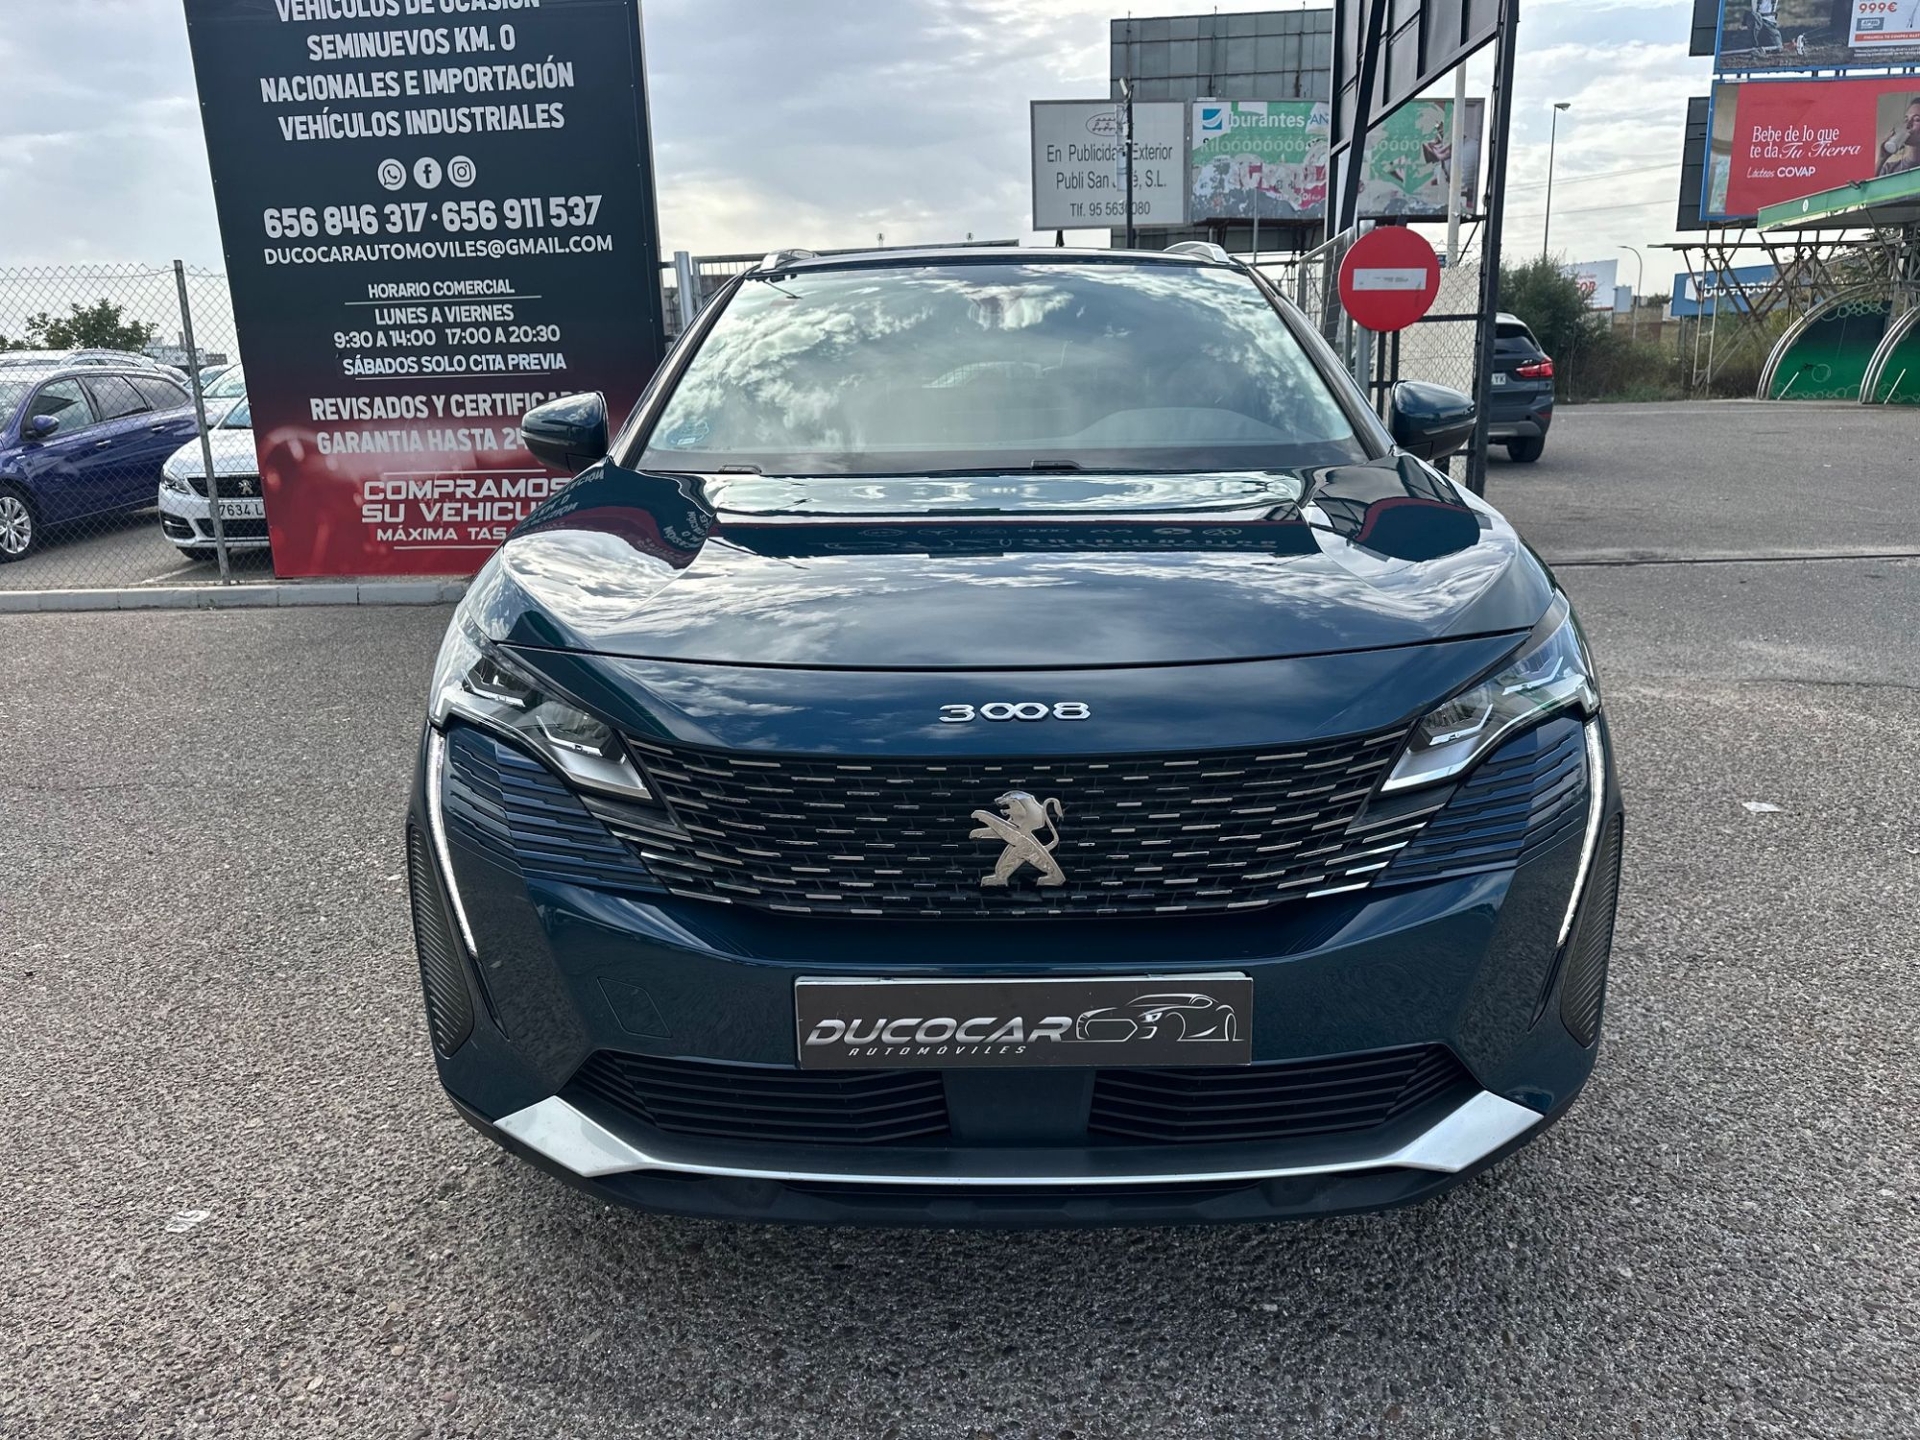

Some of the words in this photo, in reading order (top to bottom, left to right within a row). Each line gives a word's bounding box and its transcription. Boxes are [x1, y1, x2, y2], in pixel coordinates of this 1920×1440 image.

[1859, 2, 1897, 13] 999€
[307, 28, 450, 60] SEMINUEVOS
[454, 26, 496, 53] KM.
[260, 69, 400, 103] NACIONALES
[406, 69, 420, 96] E
[423, 56, 575, 94] IMPORTACIÓN
[278, 106, 401, 141] VEHÍCULOS
[406, 102, 565, 135] INDUSTRIALES
[1229, 112, 1305, 128] burantes
[1752, 125, 1782, 142] Bebe
[1784, 125, 1800, 141] de
[1803, 124, 1814, 141] lo
[1817, 128, 1840, 143] que
[1047, 144, 1062, 162] En
[1069, 143, 1119, 162] Publicida
[1750, 144, 1762, 158] te
[1763, 142, 1779, 158] da
[1779, 142, 1805, 159] Tu
[1808, 141, 1863, 158] Tierra
[1056, 170, 1084, 190] Publi
[1087, 170, 1110, 189] San
[1145, 169, 1167, 188] S.L.
[1777, 166, 1816, 178] COVAP
[263, 207, 319, 239] 656
[324, 204, 379, 236] 846
[504, 197, 545, 230] 911
[549, 194, 603, 228] 537
[1089, 202, 1103, 216] 95
[1106, 200, 1151, 216] 563080
[264, 234, 614, 265] DUCOCARAUTOMOVILES@GMAIL.COM
[368, 282, 431, 299] HORARIO
[433, 278, 515, 297] COMERCIAL
[375, 307, 427, 325] LUNES
[430, 306, 443, 323] A
[444, 303, 514, 323] VIERNES
[334, 330, 373, 349] 9:30
[376, 331, 388, 348] A
[390, 328, 436, 347] 14:00
[446, 327, 489, 346] 17:00
[494, 326, 505, 343] A
[508, 325, 561, 343] 20:30
[343, 354, 419, 376] SÁBADOS
[421, 355, 467, 374] SOLO
[470, 354, 505, 372] CITA
[508, 353, 567, 371] PREVIA
[309, 395, 428, 420] REVISADOS
[430, 394, 447, 418] Y
[316, 429, 425, 454] GARANTIA
[428, 427, 500, 453] HASTA
[364, 477, 574, 500] COMPRAMOS
[219, 504, 250, 516] 7634
[362, 502, 405, 523] SU
[419, 501, 543, 522] VEHICU
[377, 525, 458, 541] MÁXIMA
[467, 526, 513, 540] TAS
[939, 701, 1092, 722] 3008
[804, 1016, 1074, 1046] DUCOCAR
[848, 1044, 1027, 1057] AUTOMÓVILES
